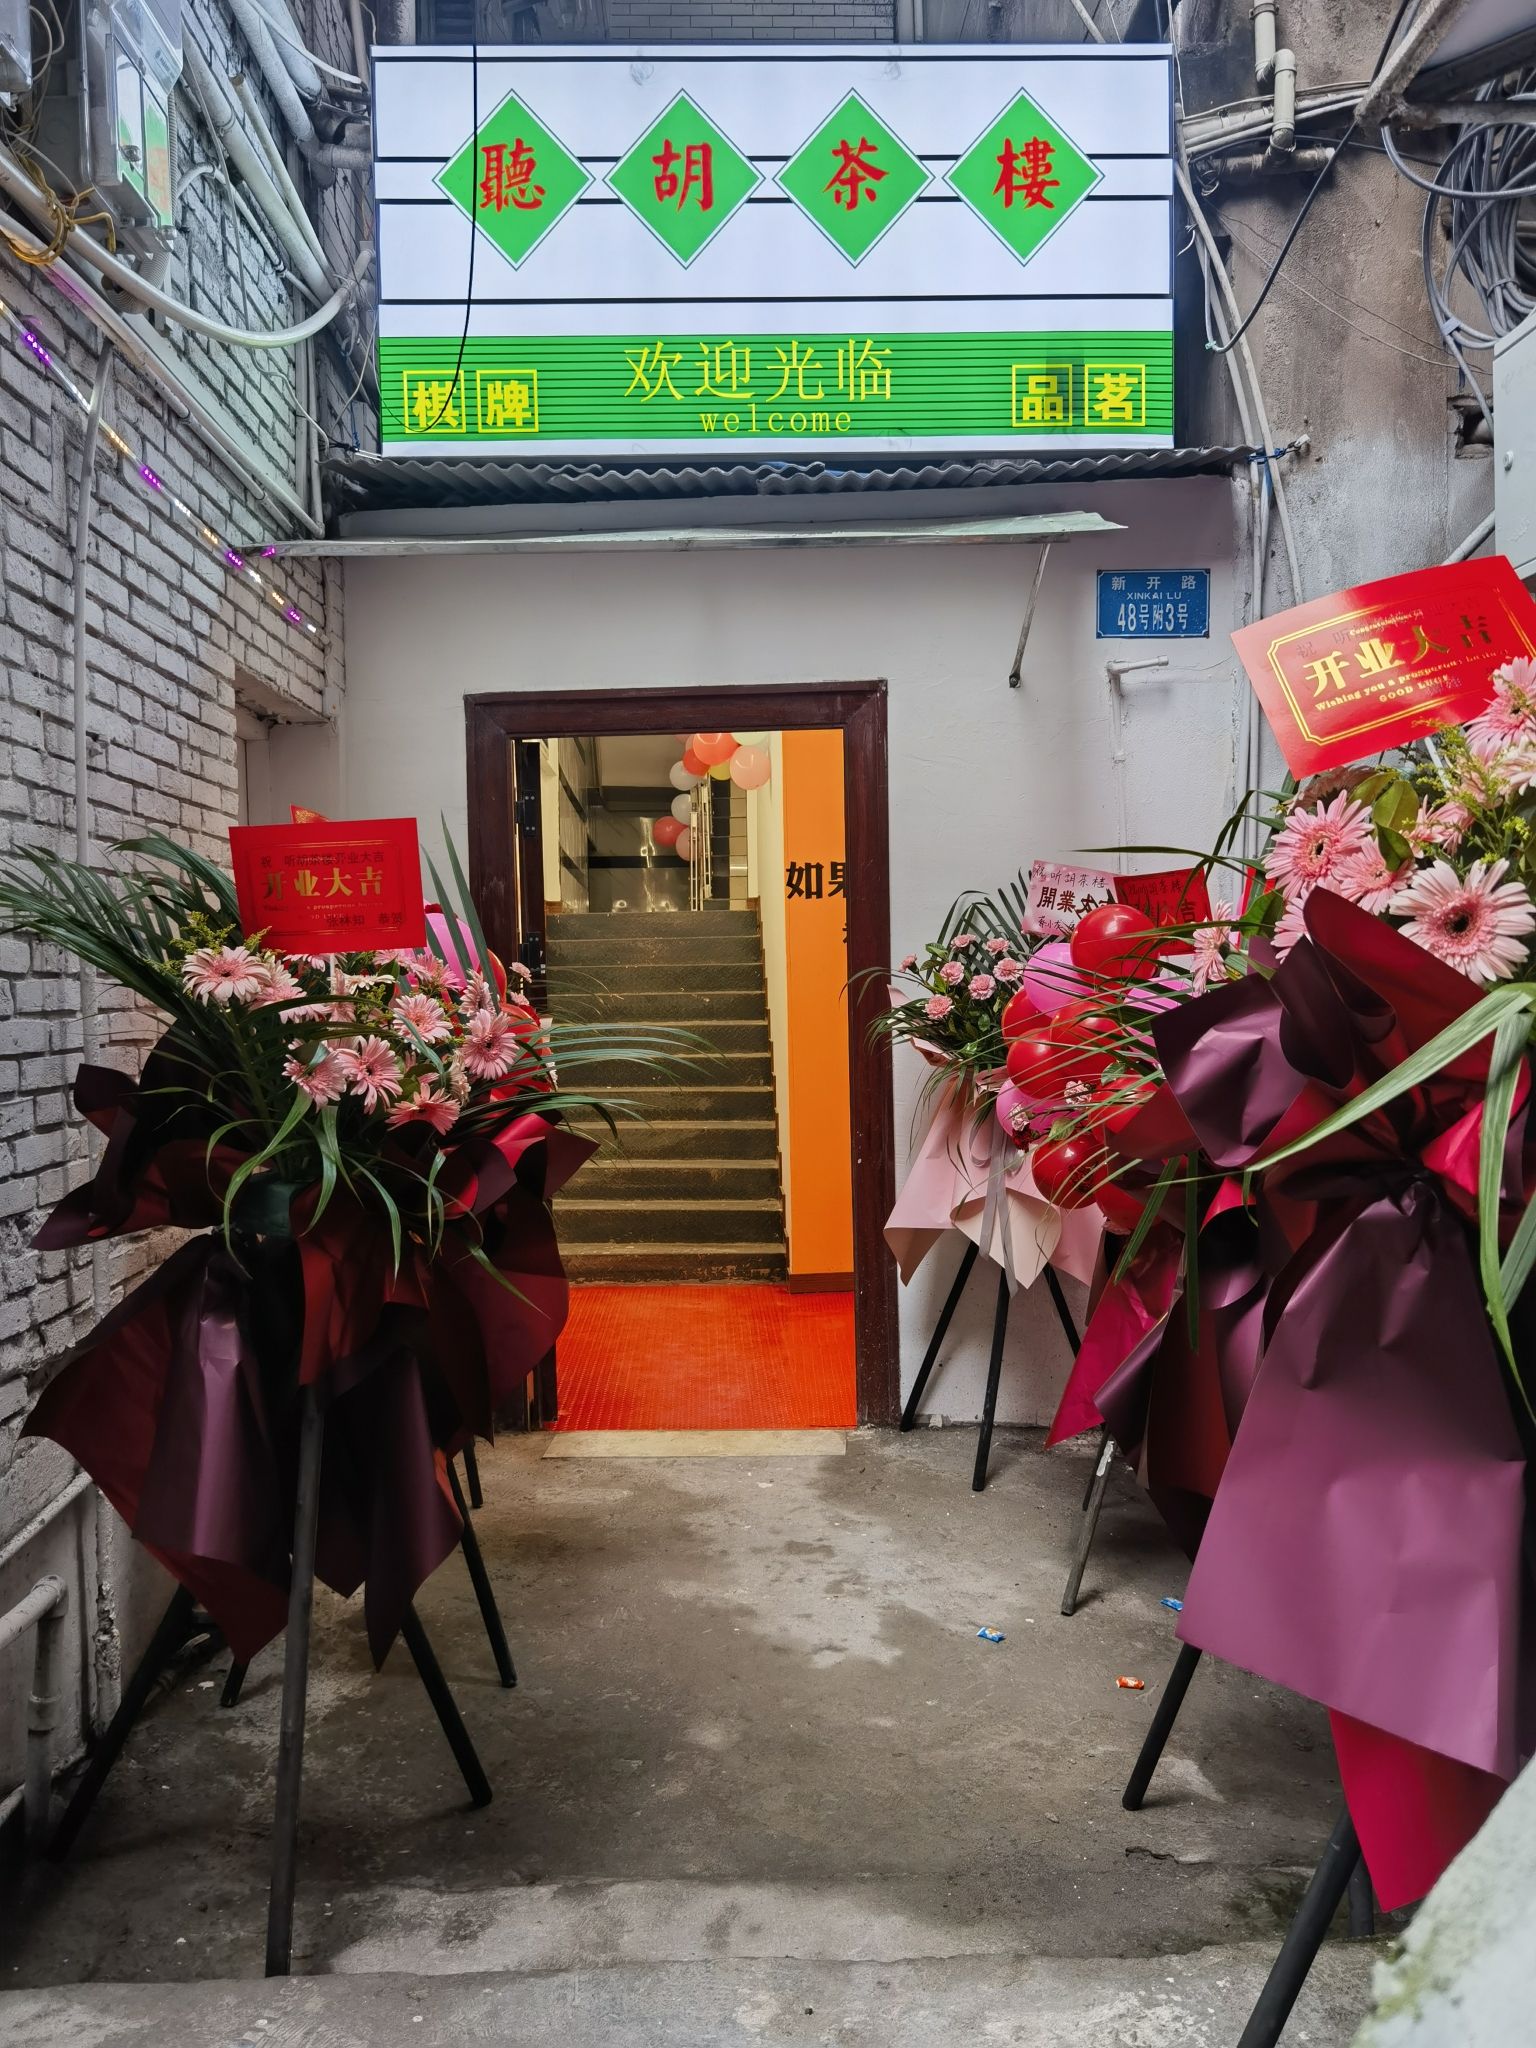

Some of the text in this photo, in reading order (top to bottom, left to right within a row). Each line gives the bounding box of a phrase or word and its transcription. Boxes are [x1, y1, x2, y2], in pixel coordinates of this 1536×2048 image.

[480, 137, 1061, 212] 聽胡茶樓
[623, 338, 894, 404] 欢迎光临
[411, 379, 537, 429] 棋牌
[1021, 372, 1140, 423] 品茗
[699, 404, 853, 433] welcome
[1111, 575, 1197, 591] 新开路
[1126, 592, 1182, 600] XINKAI LU
[1117, 603, 1189, 632] 48号附3号
[1315, 690, 1362, 712] Wishing
[1363, 682, 1386, 696] you
[1379, 685, 1414, 703] GOOD
[261, 865, 384, 900] 开业大吉
